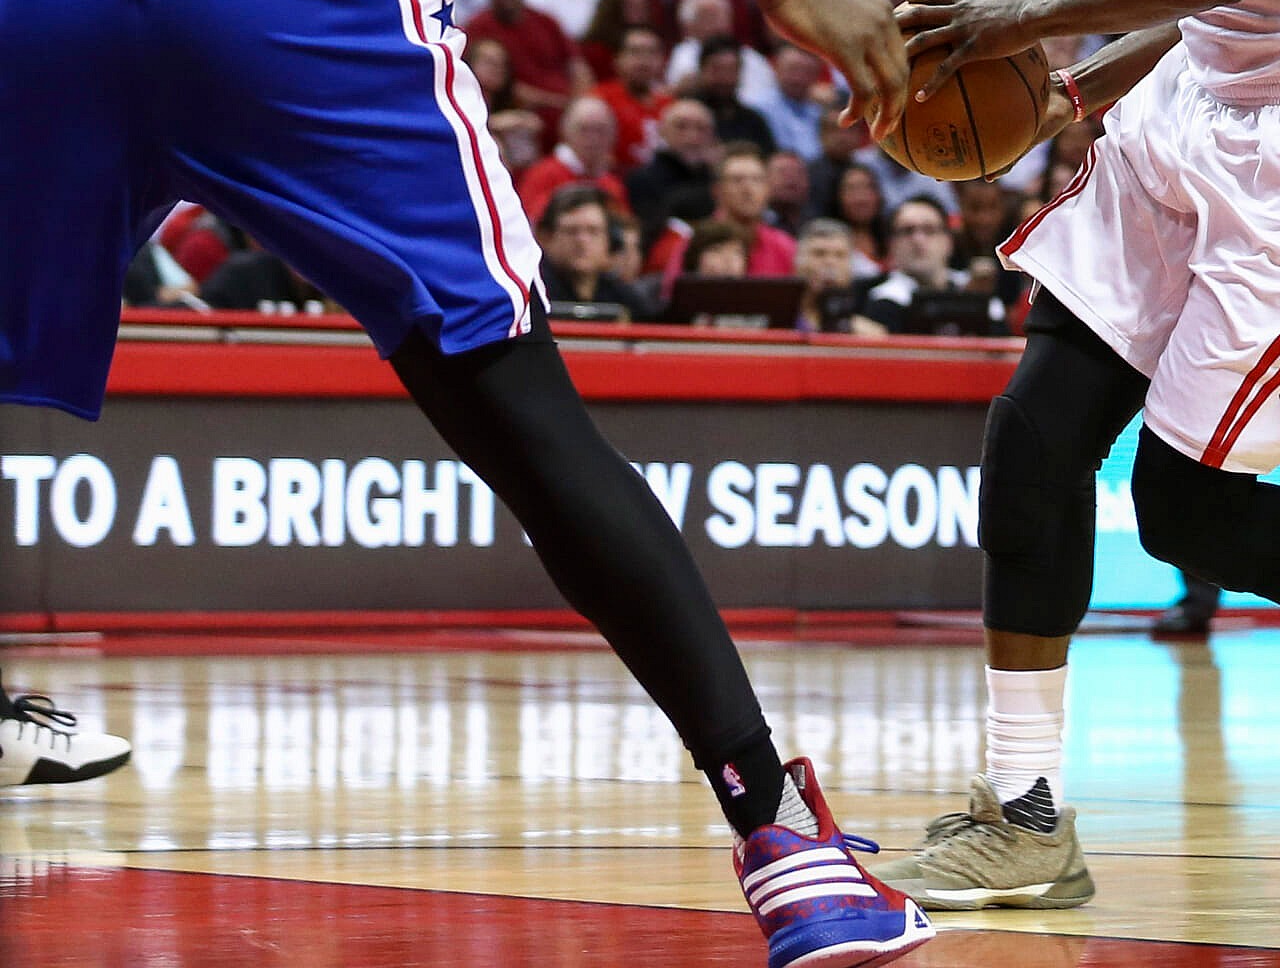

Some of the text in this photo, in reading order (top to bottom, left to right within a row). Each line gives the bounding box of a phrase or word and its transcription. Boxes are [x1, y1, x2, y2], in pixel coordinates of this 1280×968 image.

[2, 453, 118, 548] TO
[132, 455, 196, 547] A
[212, 456, 496, 549] BRIGHT
[704, 460, 982, 550] SEASON
